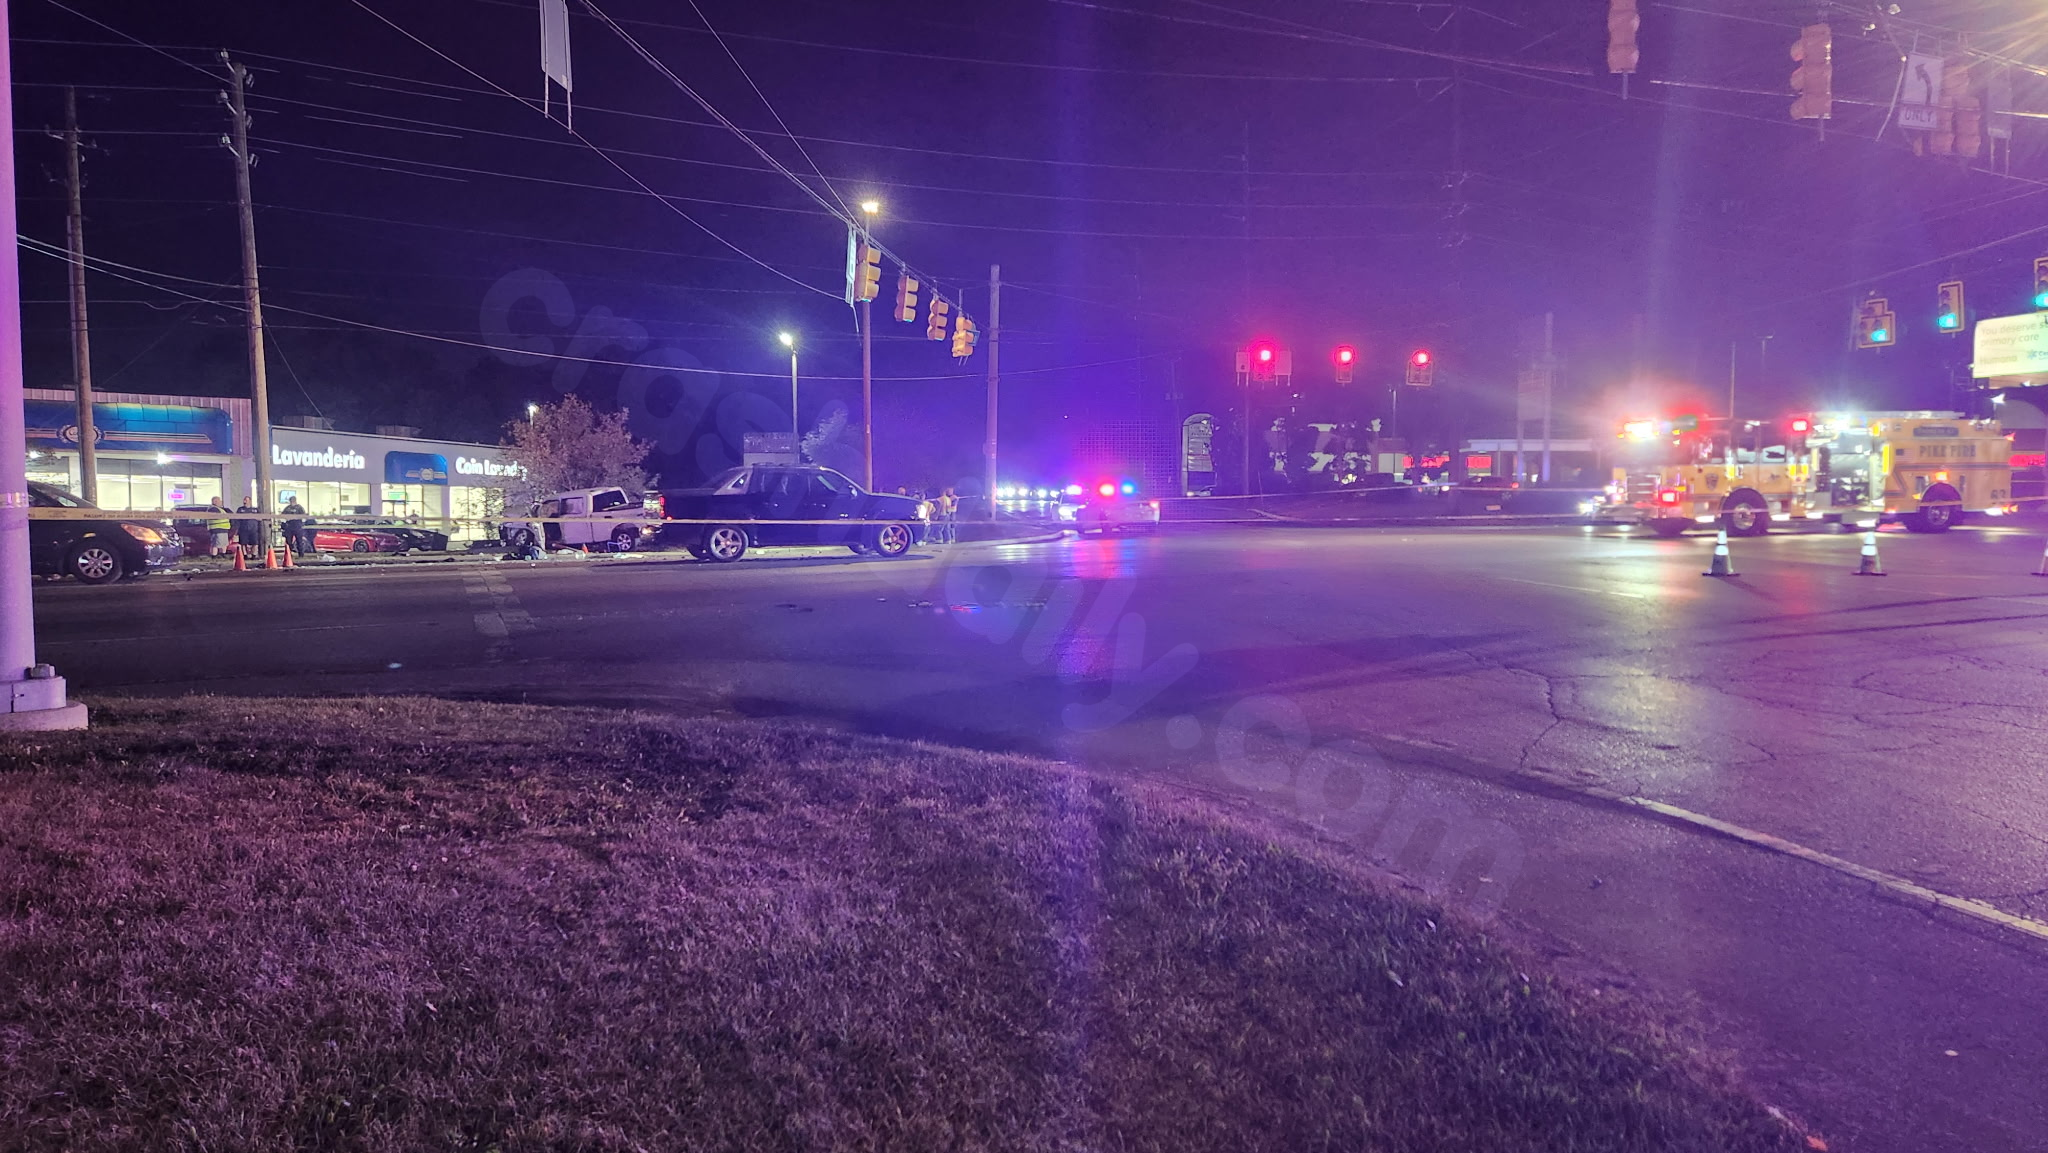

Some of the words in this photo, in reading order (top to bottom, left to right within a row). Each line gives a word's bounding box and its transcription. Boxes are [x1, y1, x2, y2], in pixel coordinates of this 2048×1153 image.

[1904, 107, 1933, 123] ONLY
[1950, 445, 1976, 457] FIRE
[455, 456, 484, 475] Coin
